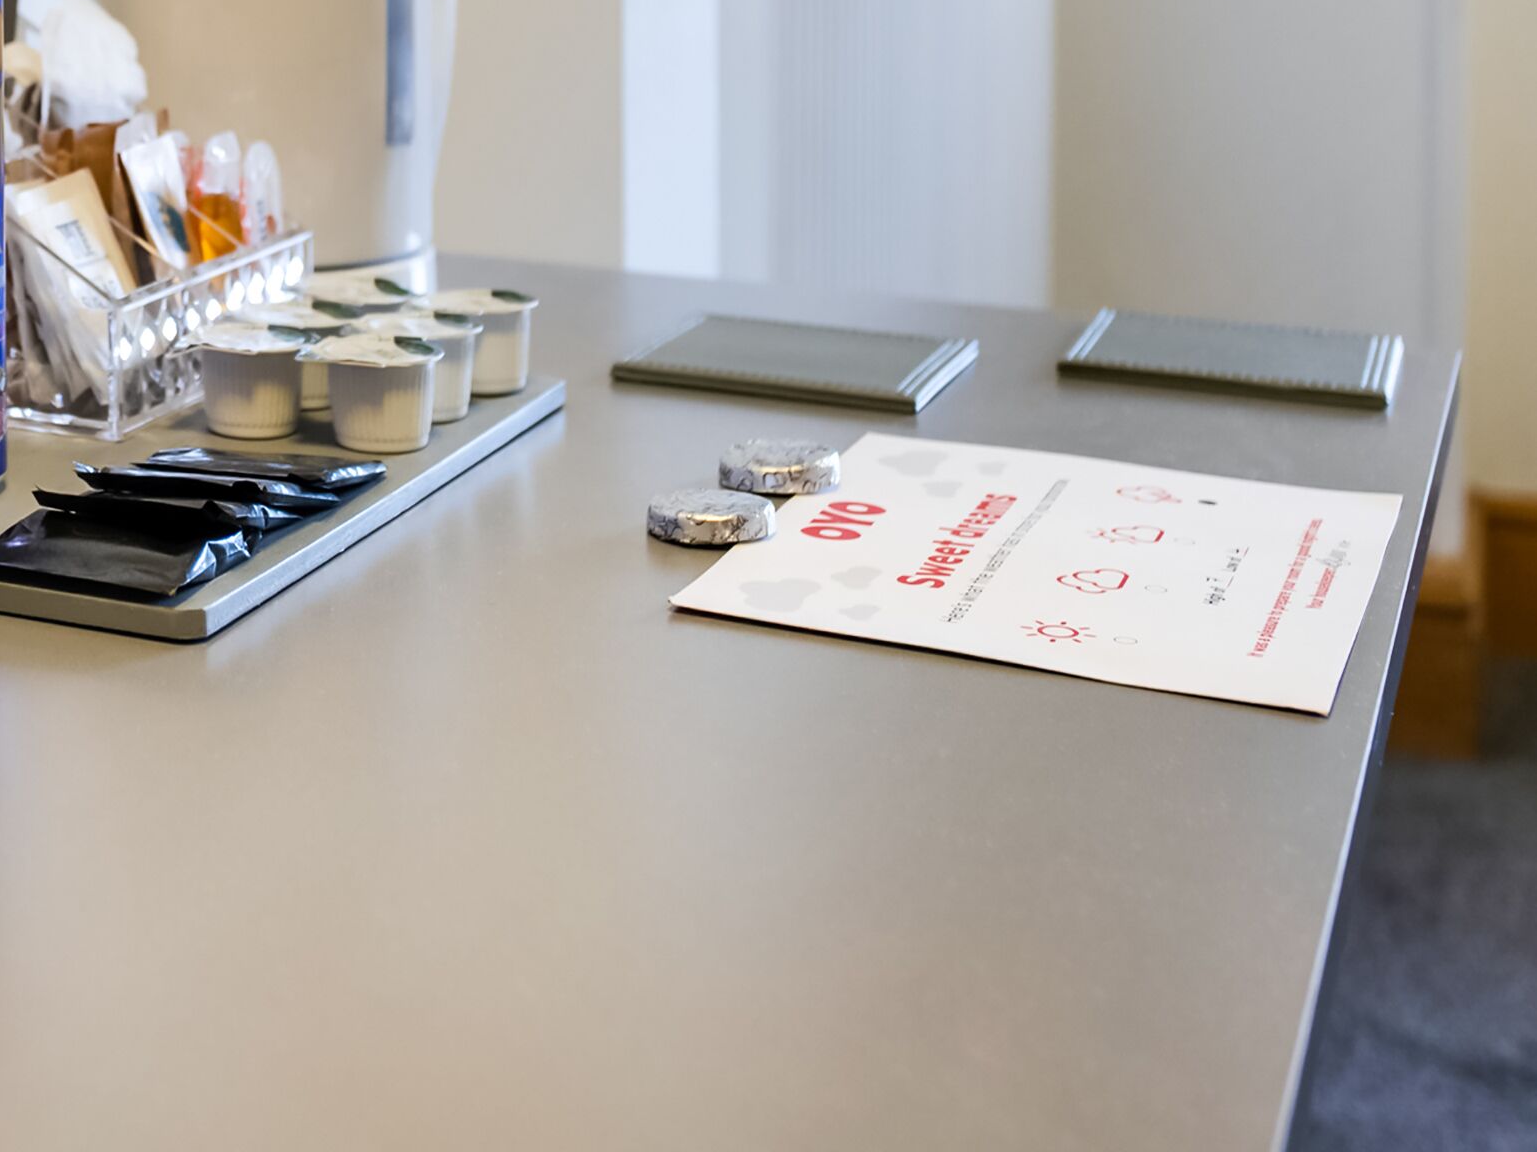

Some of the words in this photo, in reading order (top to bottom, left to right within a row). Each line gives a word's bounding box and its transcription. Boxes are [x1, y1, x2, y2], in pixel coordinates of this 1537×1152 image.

[800, 501, 886, 541] OYO
[896, 539, 975, 589] Sweet
[939, 493, 1017, 539] dreams
